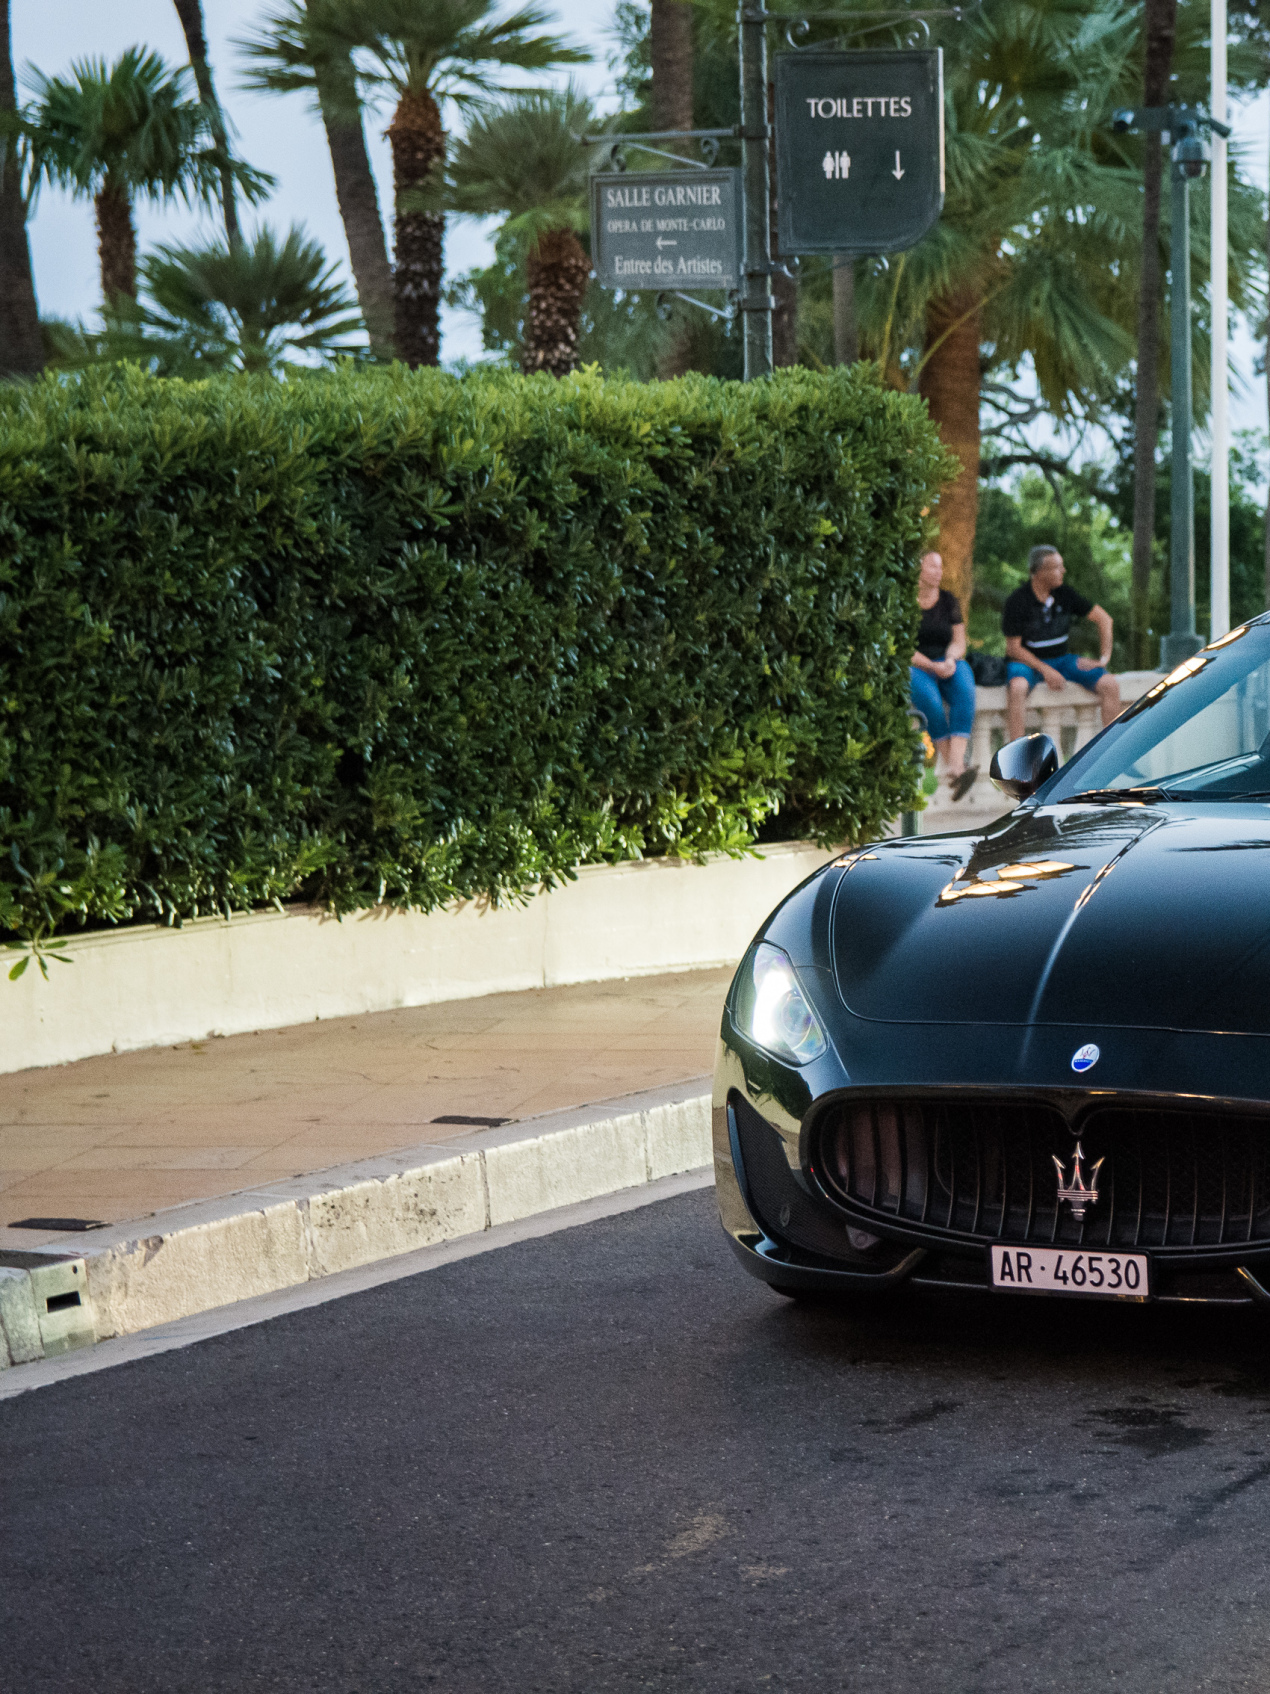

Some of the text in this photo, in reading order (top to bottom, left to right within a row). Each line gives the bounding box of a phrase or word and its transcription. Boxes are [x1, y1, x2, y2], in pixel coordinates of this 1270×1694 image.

[806, 96, 912, 118] TOILETTES
[607, 185, 721, 208] SALLE GARNIER
[641, 218, 655, 232] DE
[656, 216, 726, 232] MONTE-CARLO
[653, 254, 674, 274] des
[677, 254, 723, 274] Artistes
